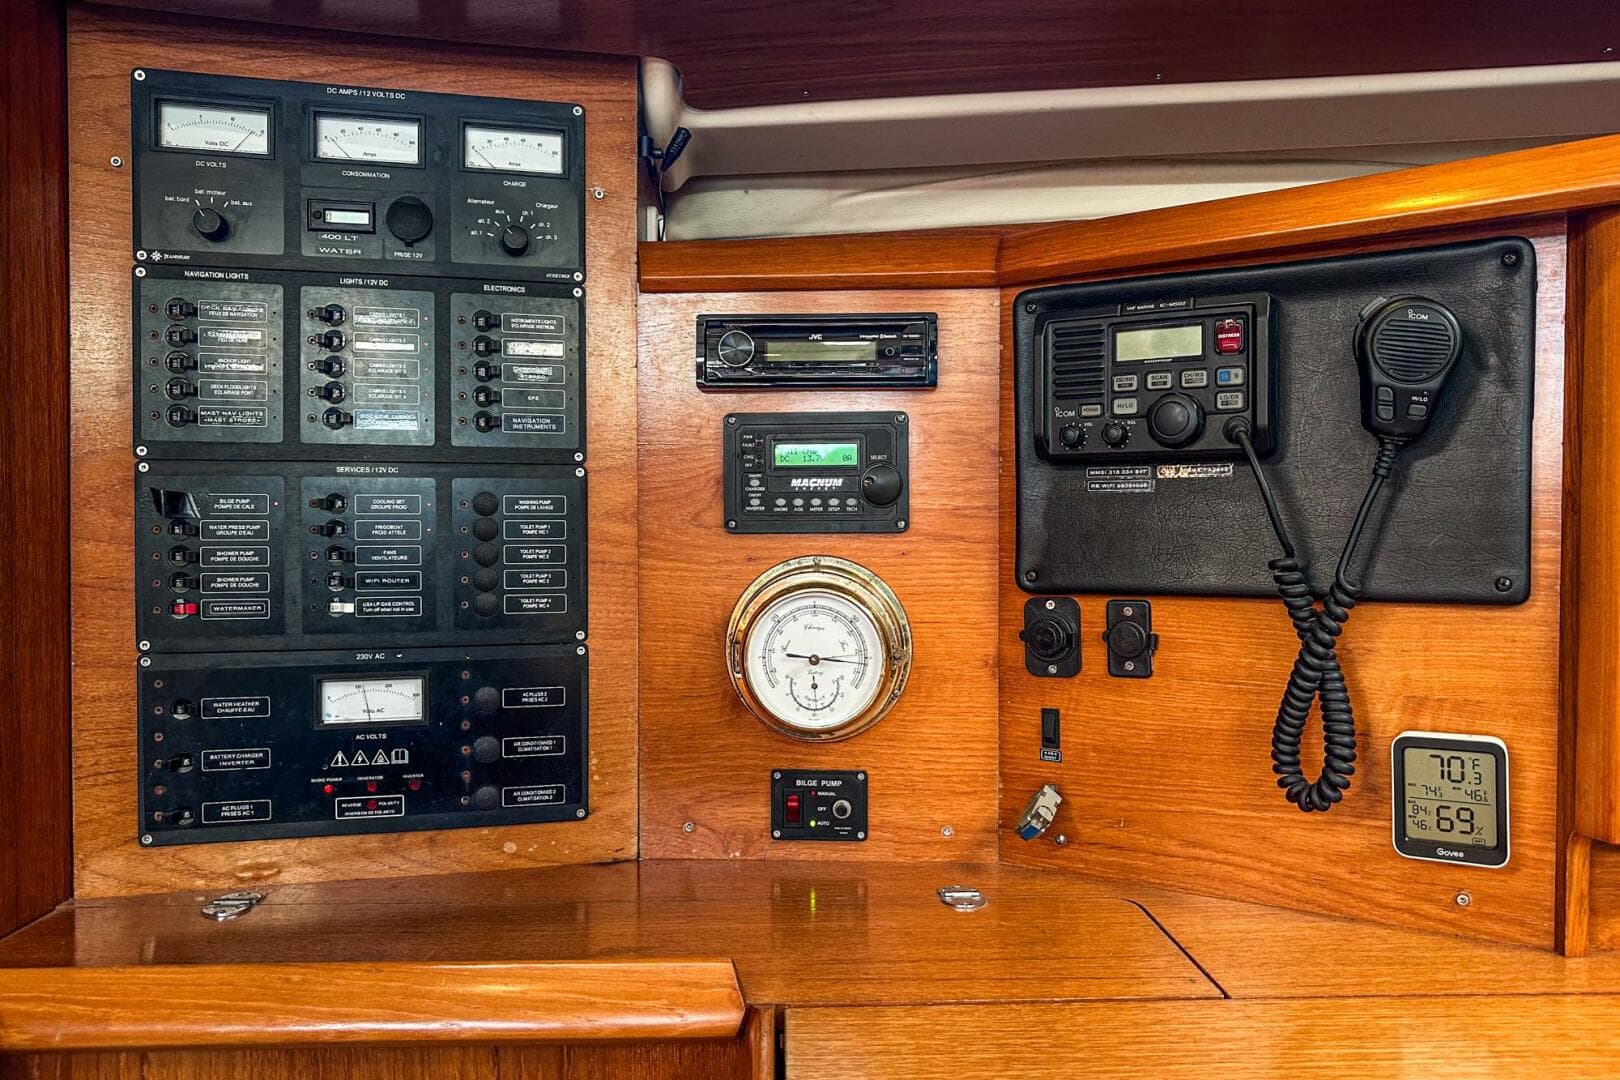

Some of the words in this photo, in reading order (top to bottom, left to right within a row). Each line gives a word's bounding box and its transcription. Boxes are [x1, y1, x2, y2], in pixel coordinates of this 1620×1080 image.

[339, 88, 358, 96] AMPS
[372, 91, 394, 99] VOLTS
[503, 180, 527, 188] CHARGE
[319, 247, 362, 255] WATER
[184, 270, 224, 279] NAVIGATION
[225, 272, 249, 280] LIGHTS
[339, 277, 363, 285] LIGHTS
[483, 284, 526, 293] ELECTRONICS
[808, 333, 823, 341] JVC
[780, 455, 790, 463] DC
[790, 478, 844, 487] MAGNUM
[796, 779, 818, 787] BILGE
[1436, 847, 1465, 858] Govee
